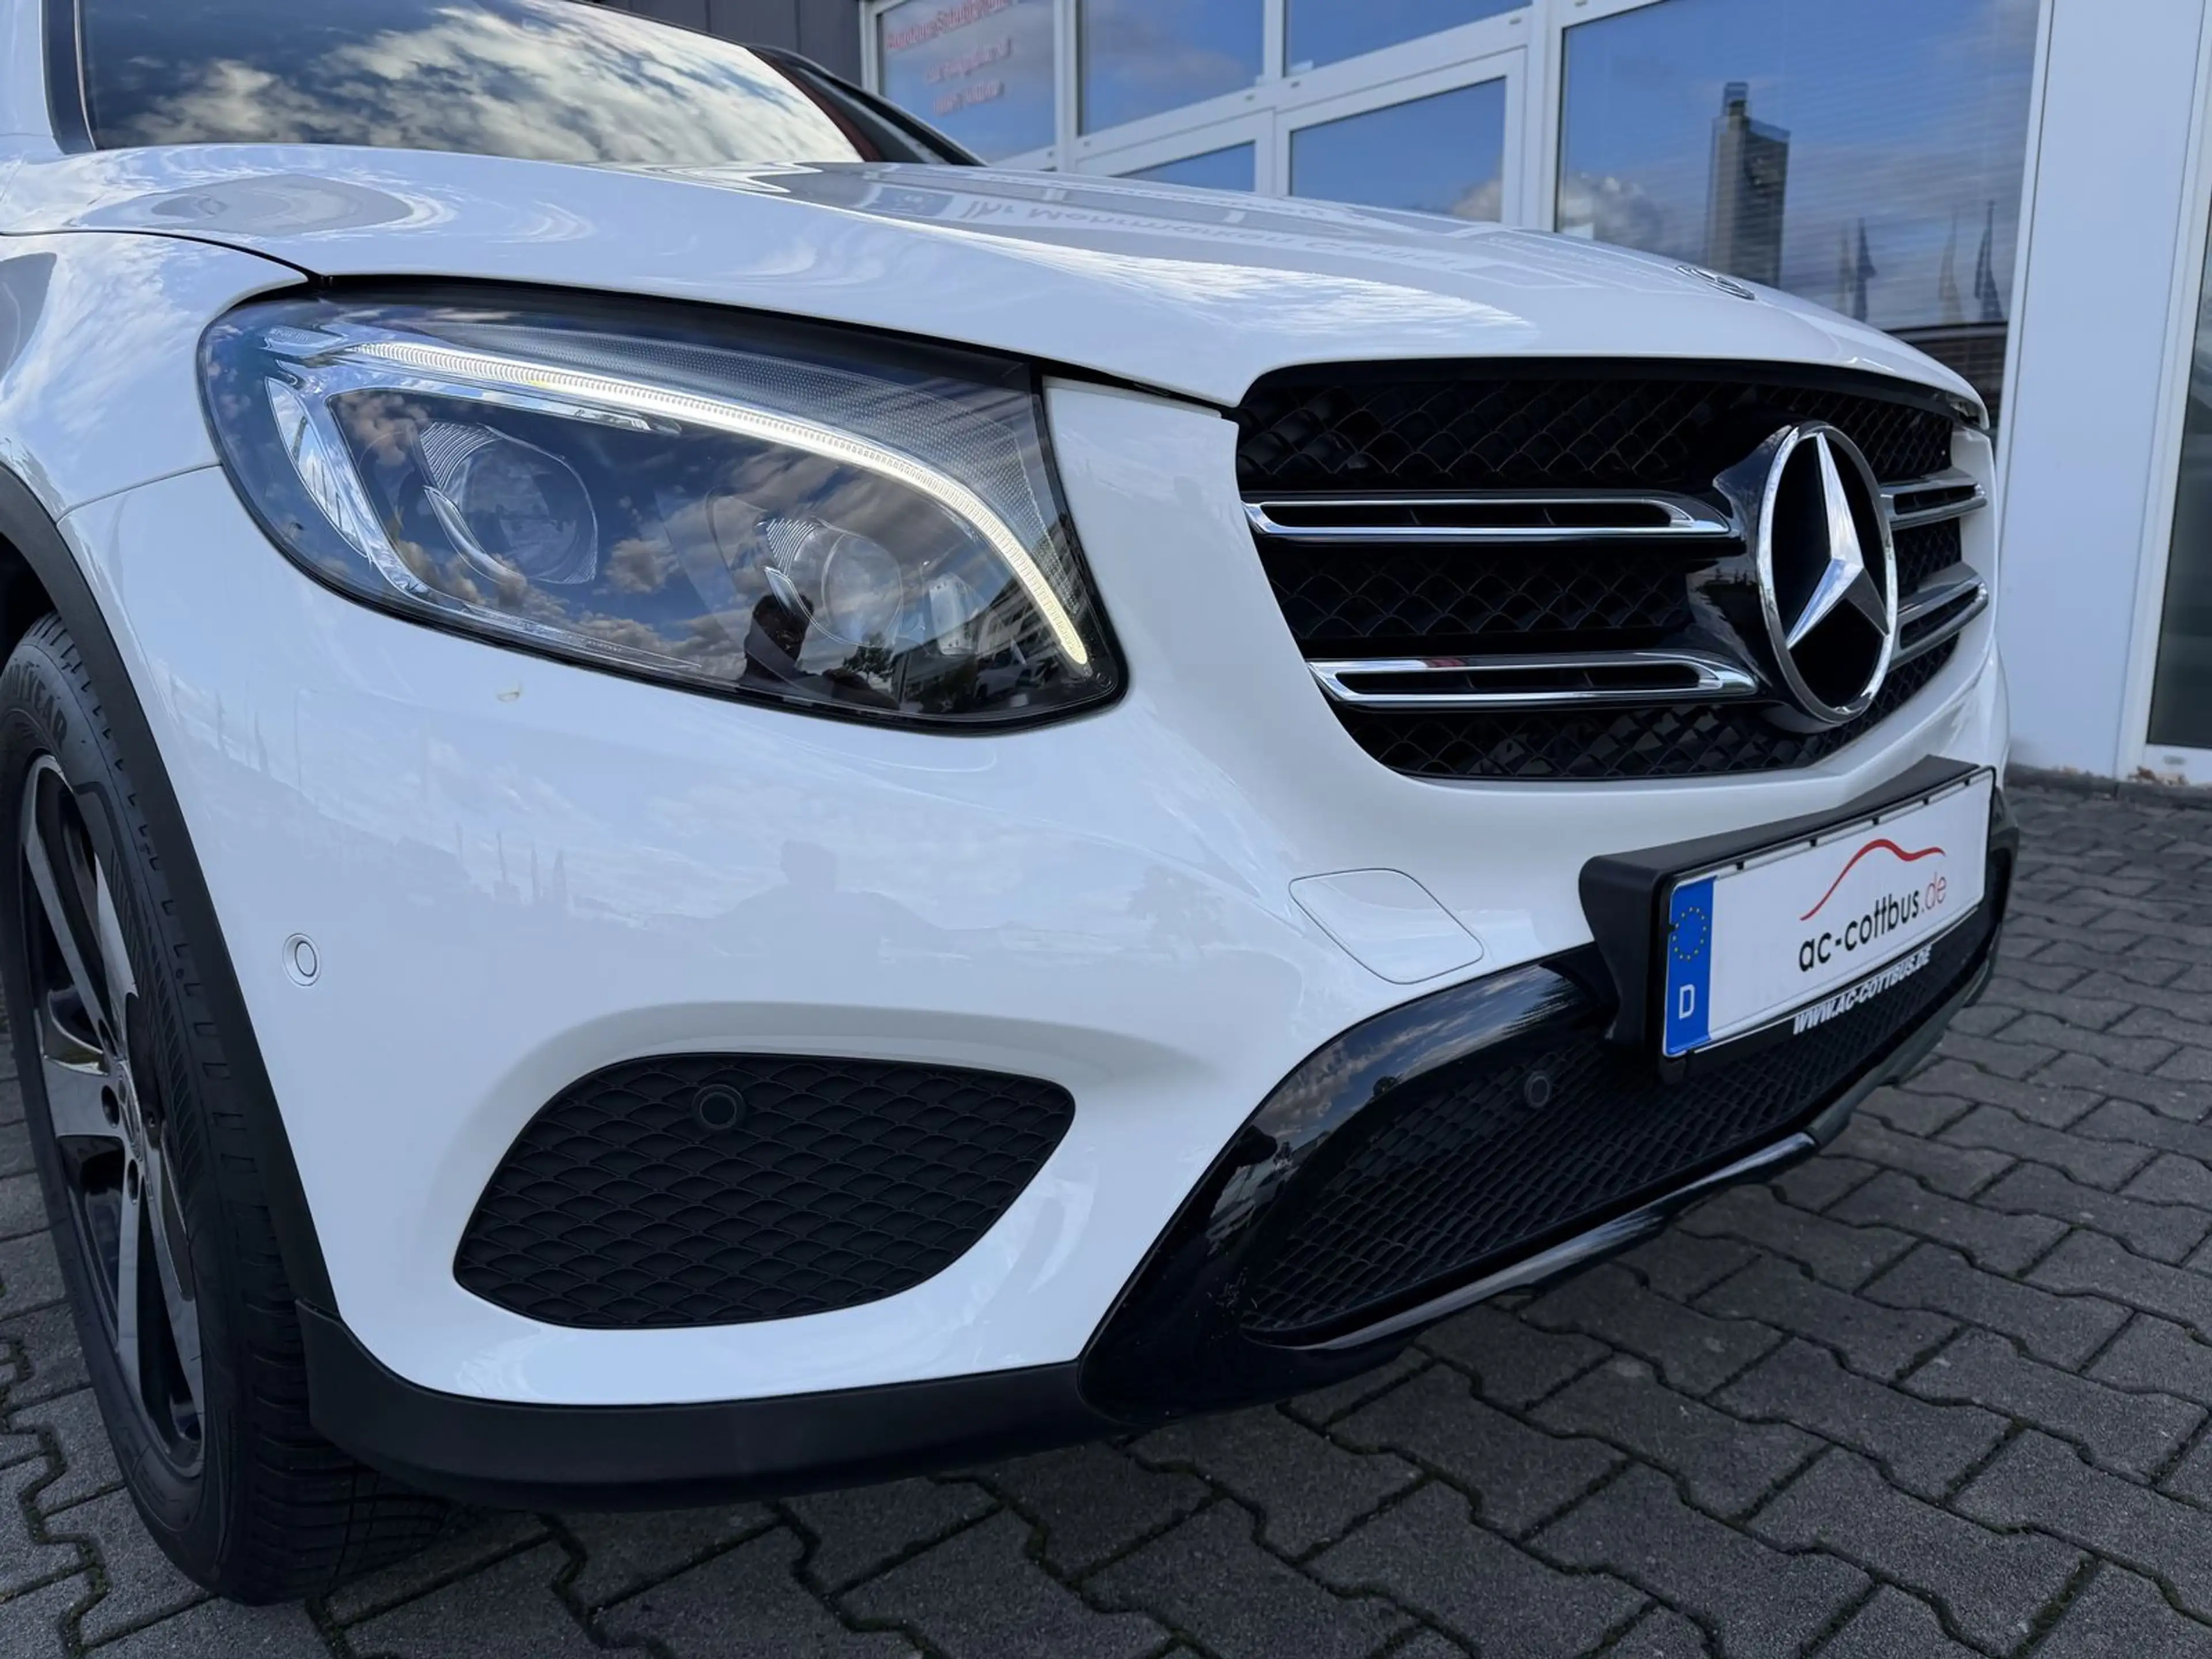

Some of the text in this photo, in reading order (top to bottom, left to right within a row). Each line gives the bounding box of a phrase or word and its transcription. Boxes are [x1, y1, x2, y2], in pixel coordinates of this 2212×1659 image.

[1798, 871, 1947, 972] ac-cottbus.de
[1678, 983, 1695, 1020] D
[1793, 943, 1932, 1036] WWW.AC-COTTBUS.DE
